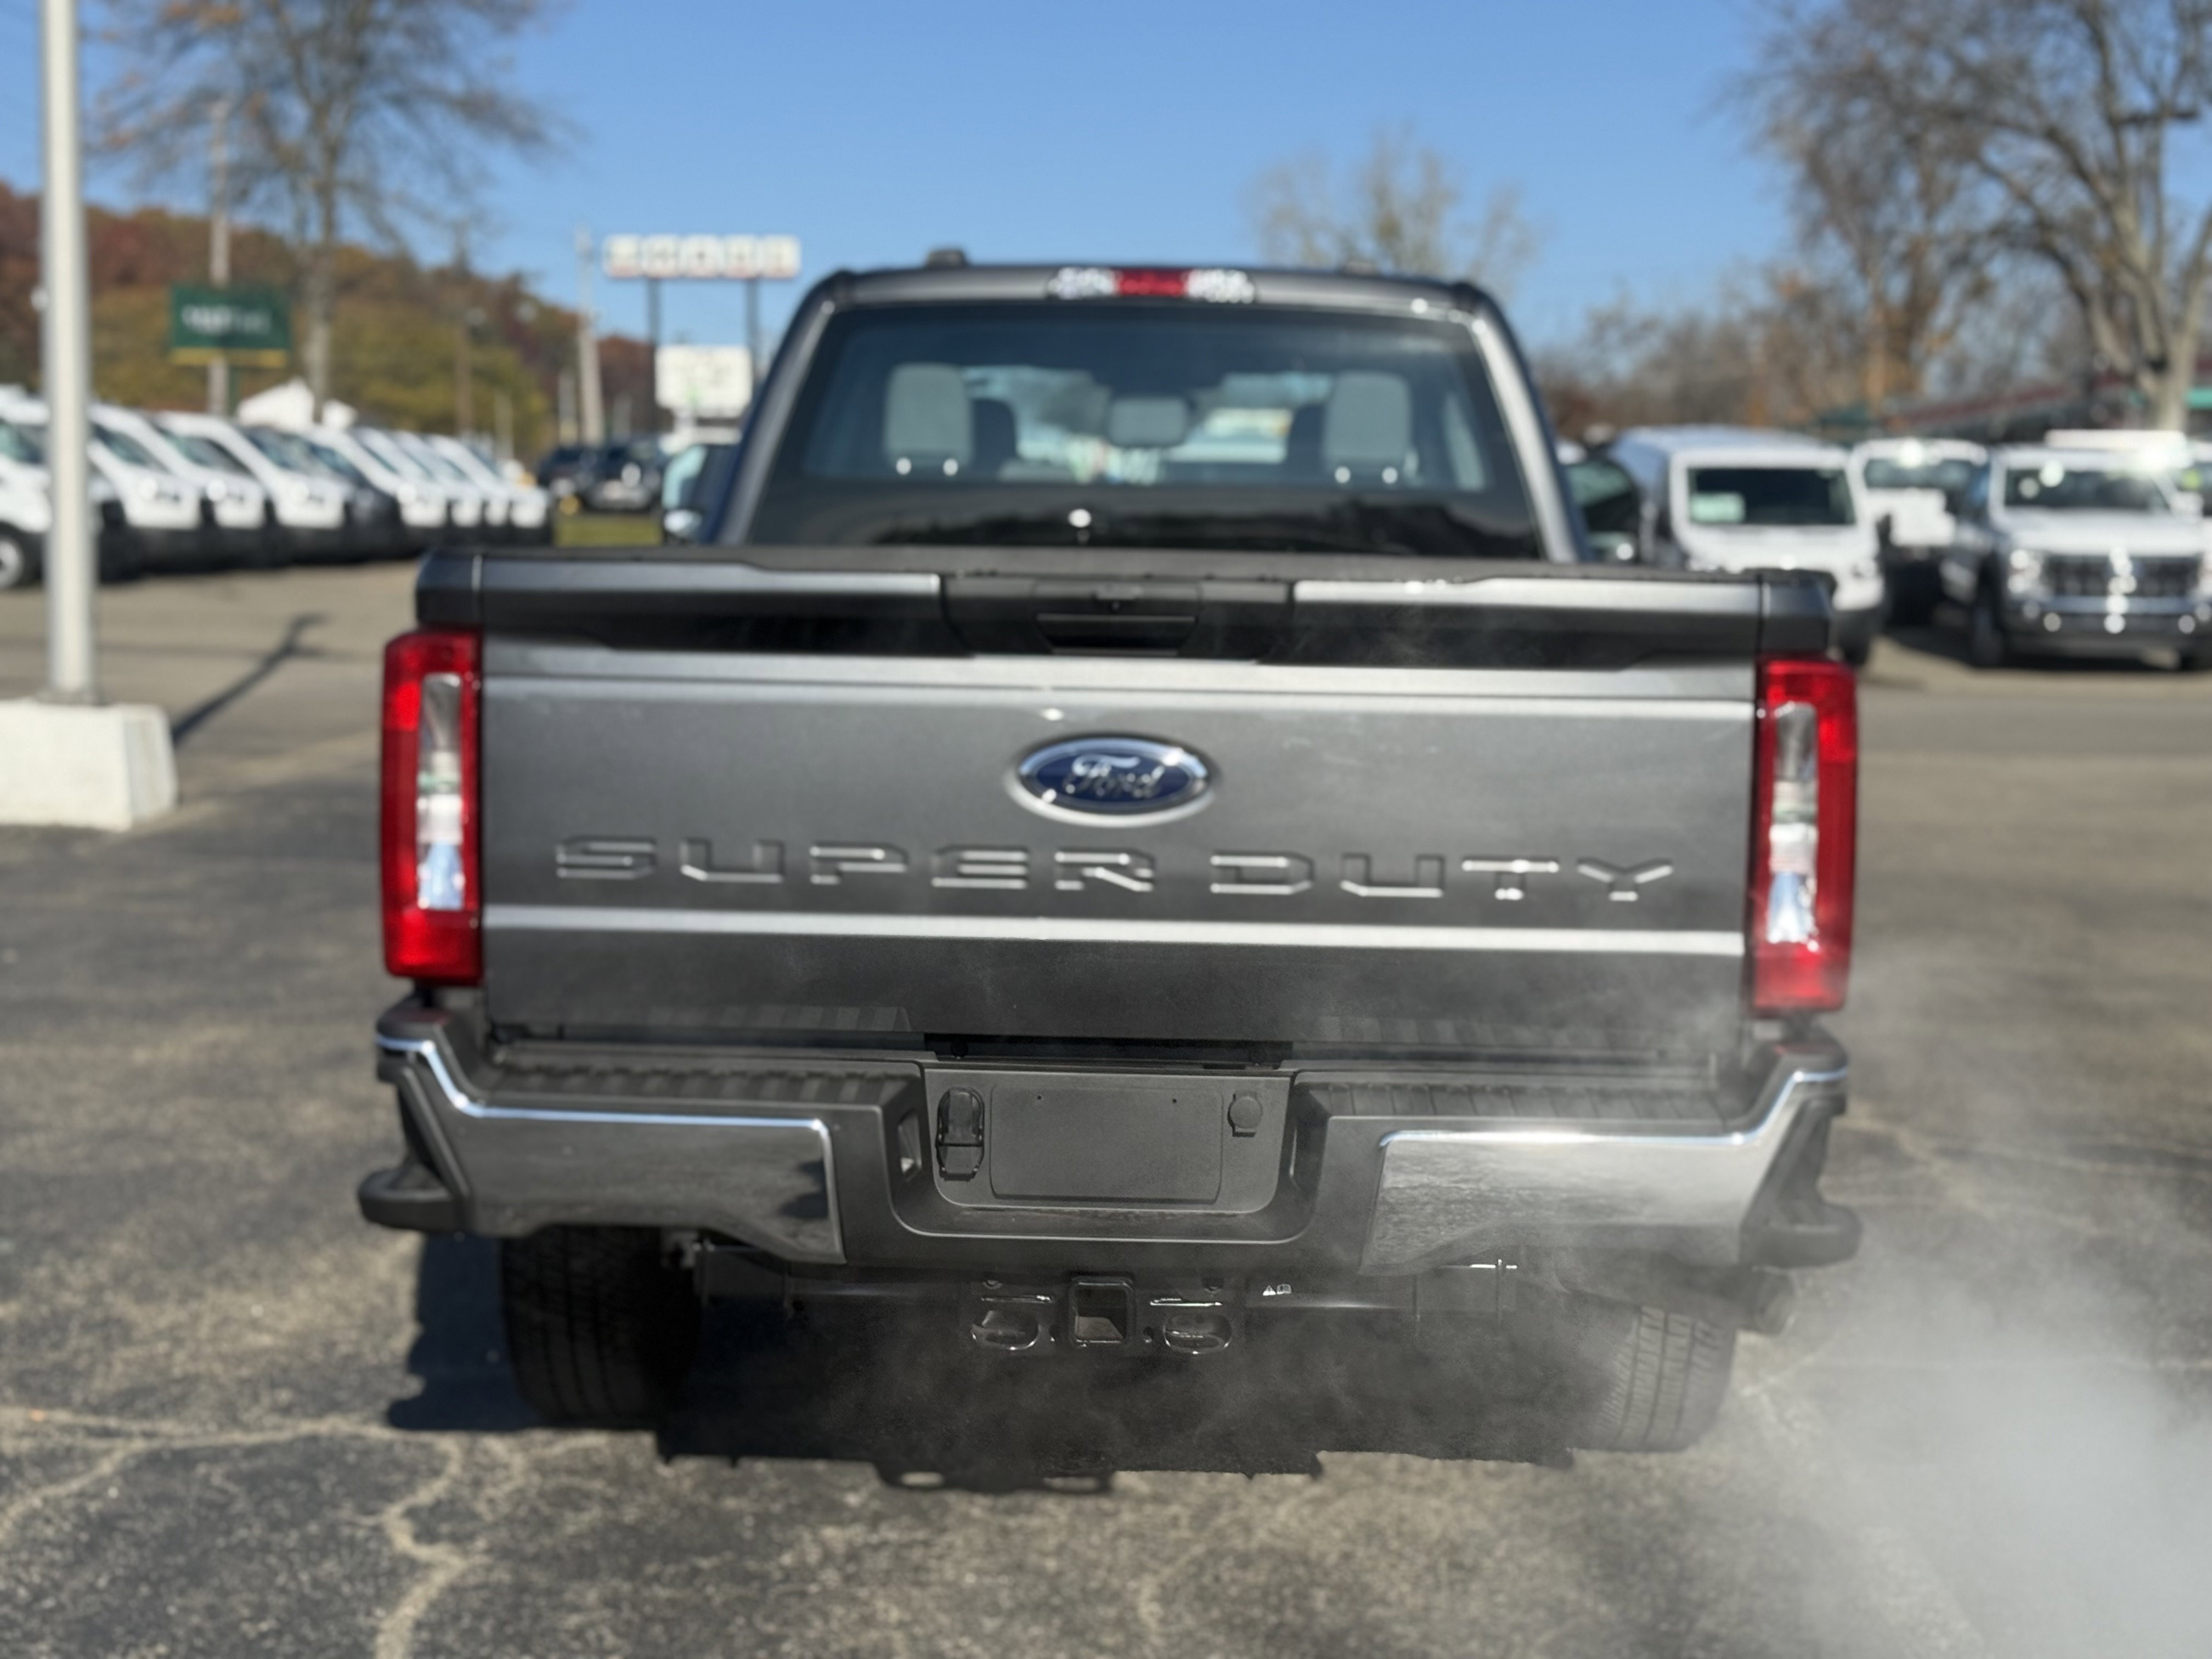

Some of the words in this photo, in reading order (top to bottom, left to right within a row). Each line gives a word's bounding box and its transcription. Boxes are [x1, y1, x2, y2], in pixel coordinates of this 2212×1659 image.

[1063, 754, 1165, 799] Ford
[555, 836, 1156, 892] SUPER
[1209, 849, 1674, 903] DUTY
